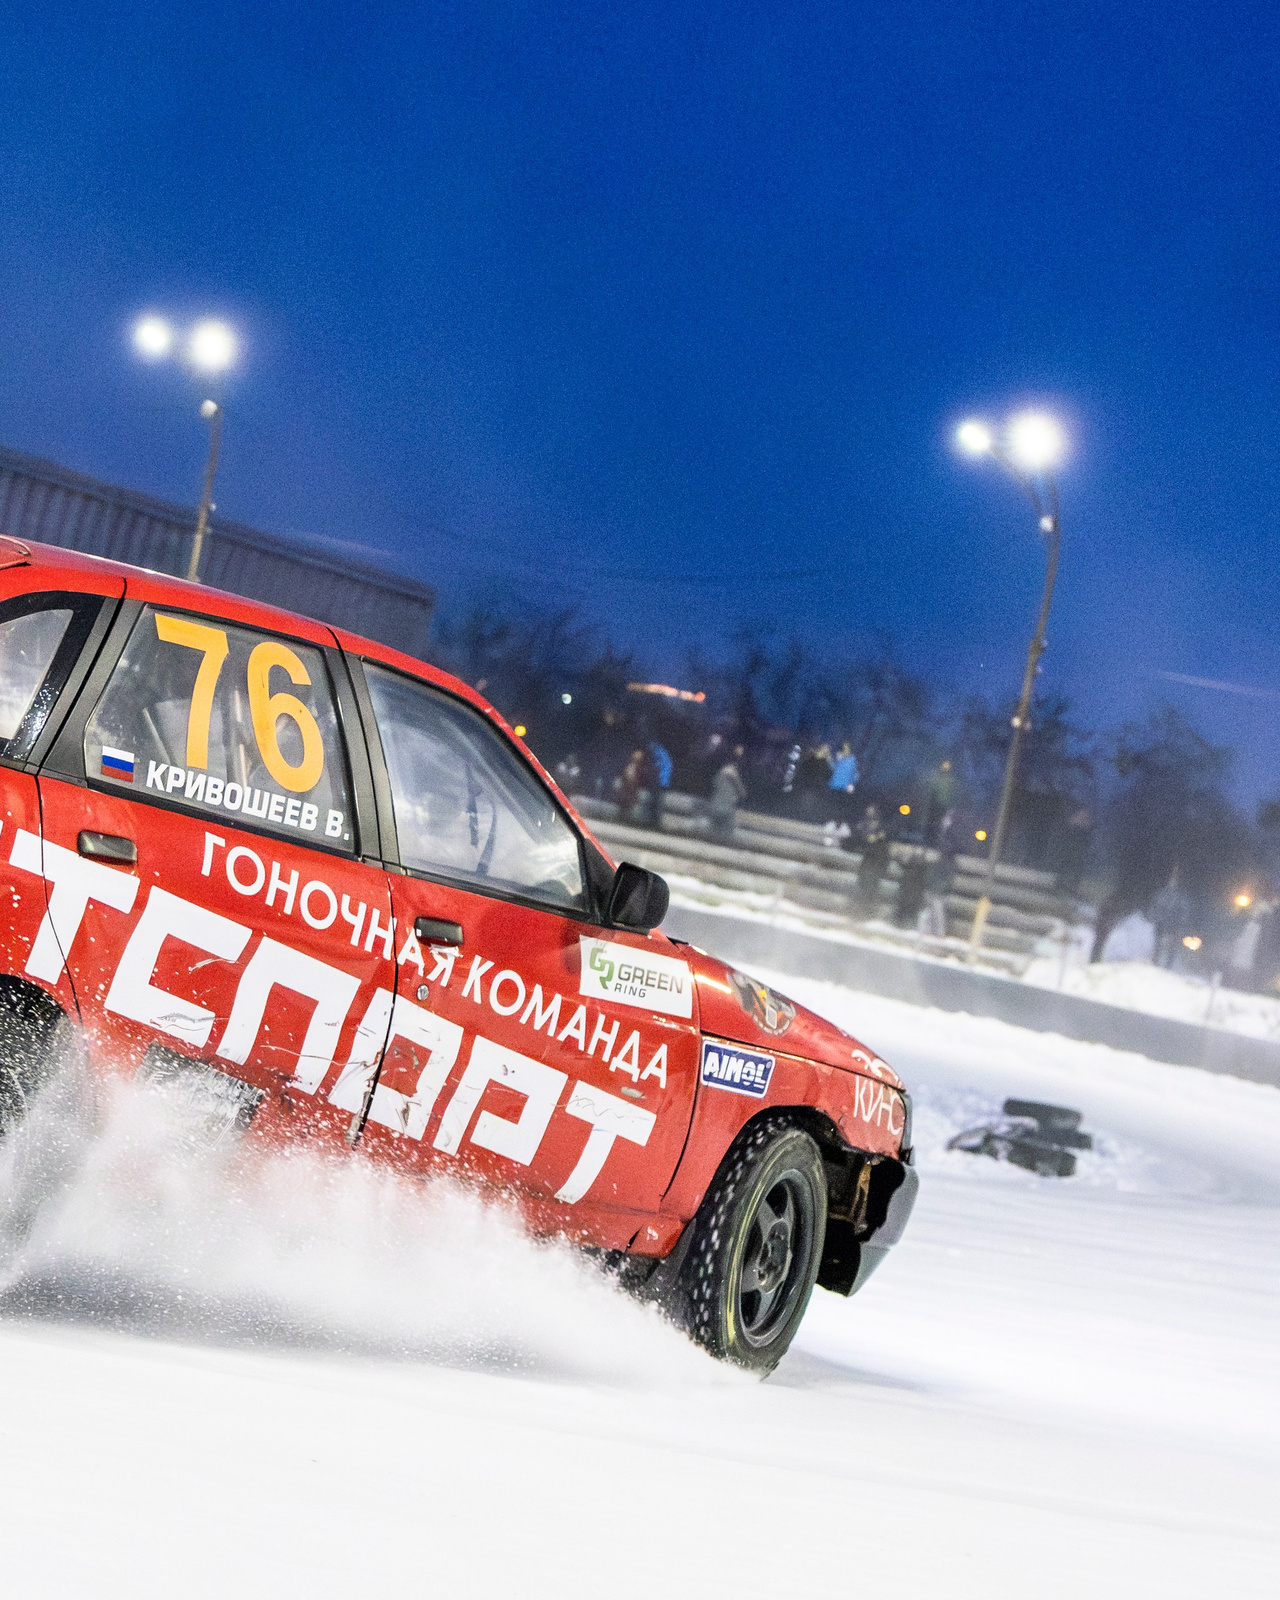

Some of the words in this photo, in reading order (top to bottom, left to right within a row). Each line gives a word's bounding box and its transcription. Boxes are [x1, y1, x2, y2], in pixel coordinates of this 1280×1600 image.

[155, 613, 323, 792] 76
[146, 760, 318, 829] КРИВОШЕЕВ
[325, 809, 349, 840] В.
[201, 832, 461, 987] ГОНОЧНАЯ
[462, 955, 668, 1088] КОМАНДА
[617, 963, 683, 994] GREEN
[614, 983, 647, 998] RING
[703, 1051, 767, 1089] AIMOL
